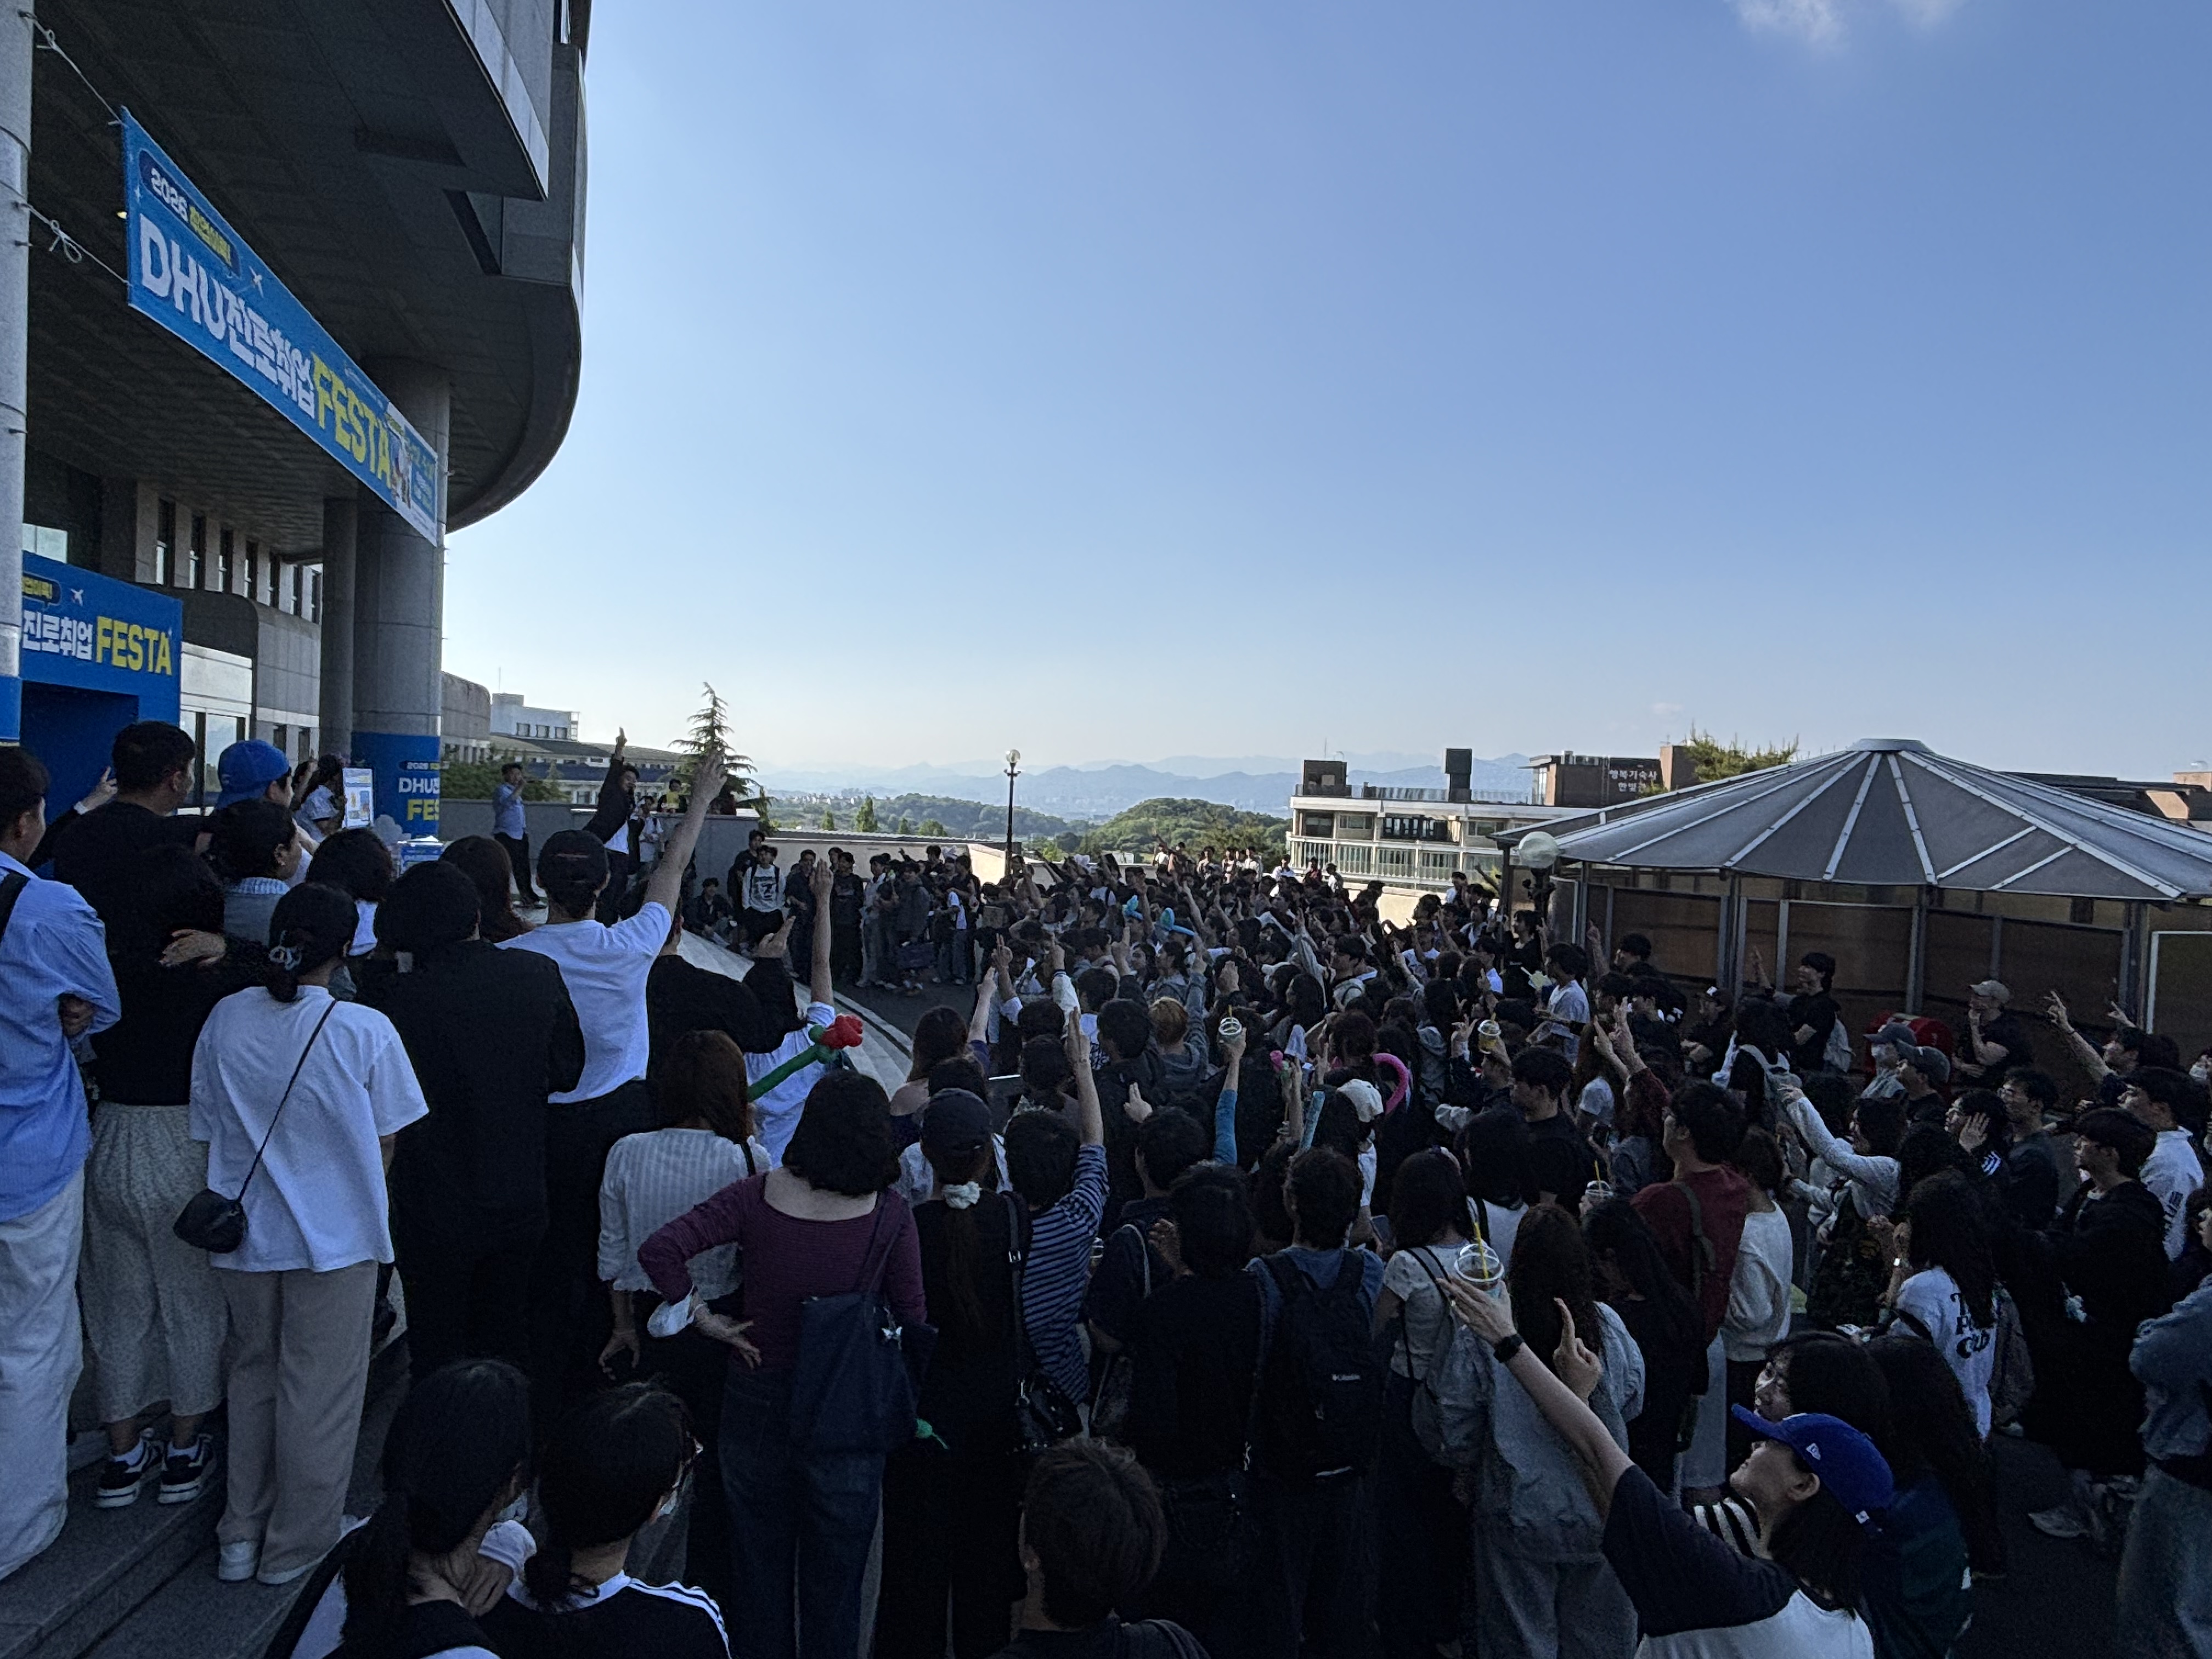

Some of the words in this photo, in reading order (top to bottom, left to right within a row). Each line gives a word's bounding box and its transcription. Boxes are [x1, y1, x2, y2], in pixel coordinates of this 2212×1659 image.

[150, 168, 189, 223] 2026
[310, 351, 392, 490] FESTA
[95, 616, 172, 676] FESTA
